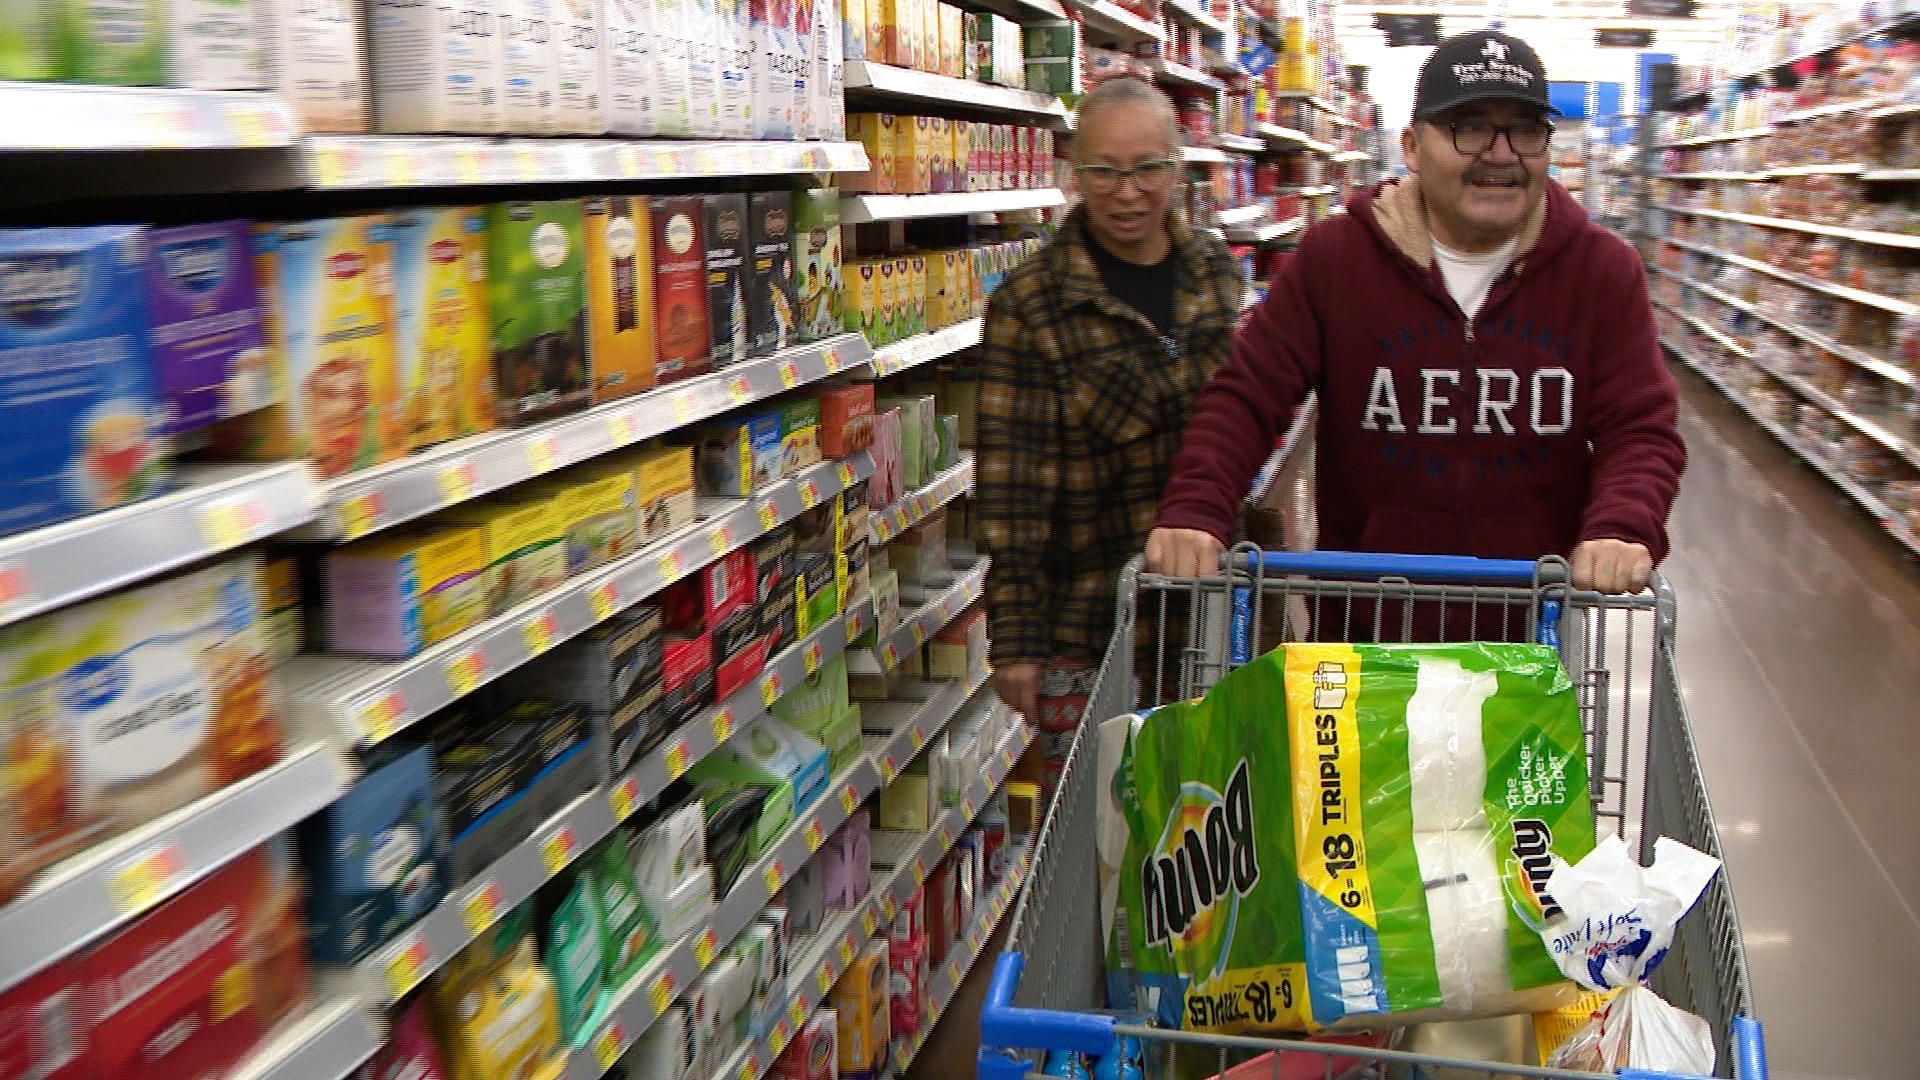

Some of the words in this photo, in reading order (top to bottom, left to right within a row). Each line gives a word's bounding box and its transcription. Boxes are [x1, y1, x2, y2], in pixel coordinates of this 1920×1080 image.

[1360, 366, 1575, 435] AERO
[1314, 714, 1341, 825] TRIPLES
[1505, 777, 1523, 810] The
[1518, 742, 1539, 805] Quicker
[1533, 755, 1552, 805] Picker
[1548, 755, 1566, 804] Upper
[1142, 758, 1259, 954] Bounty
